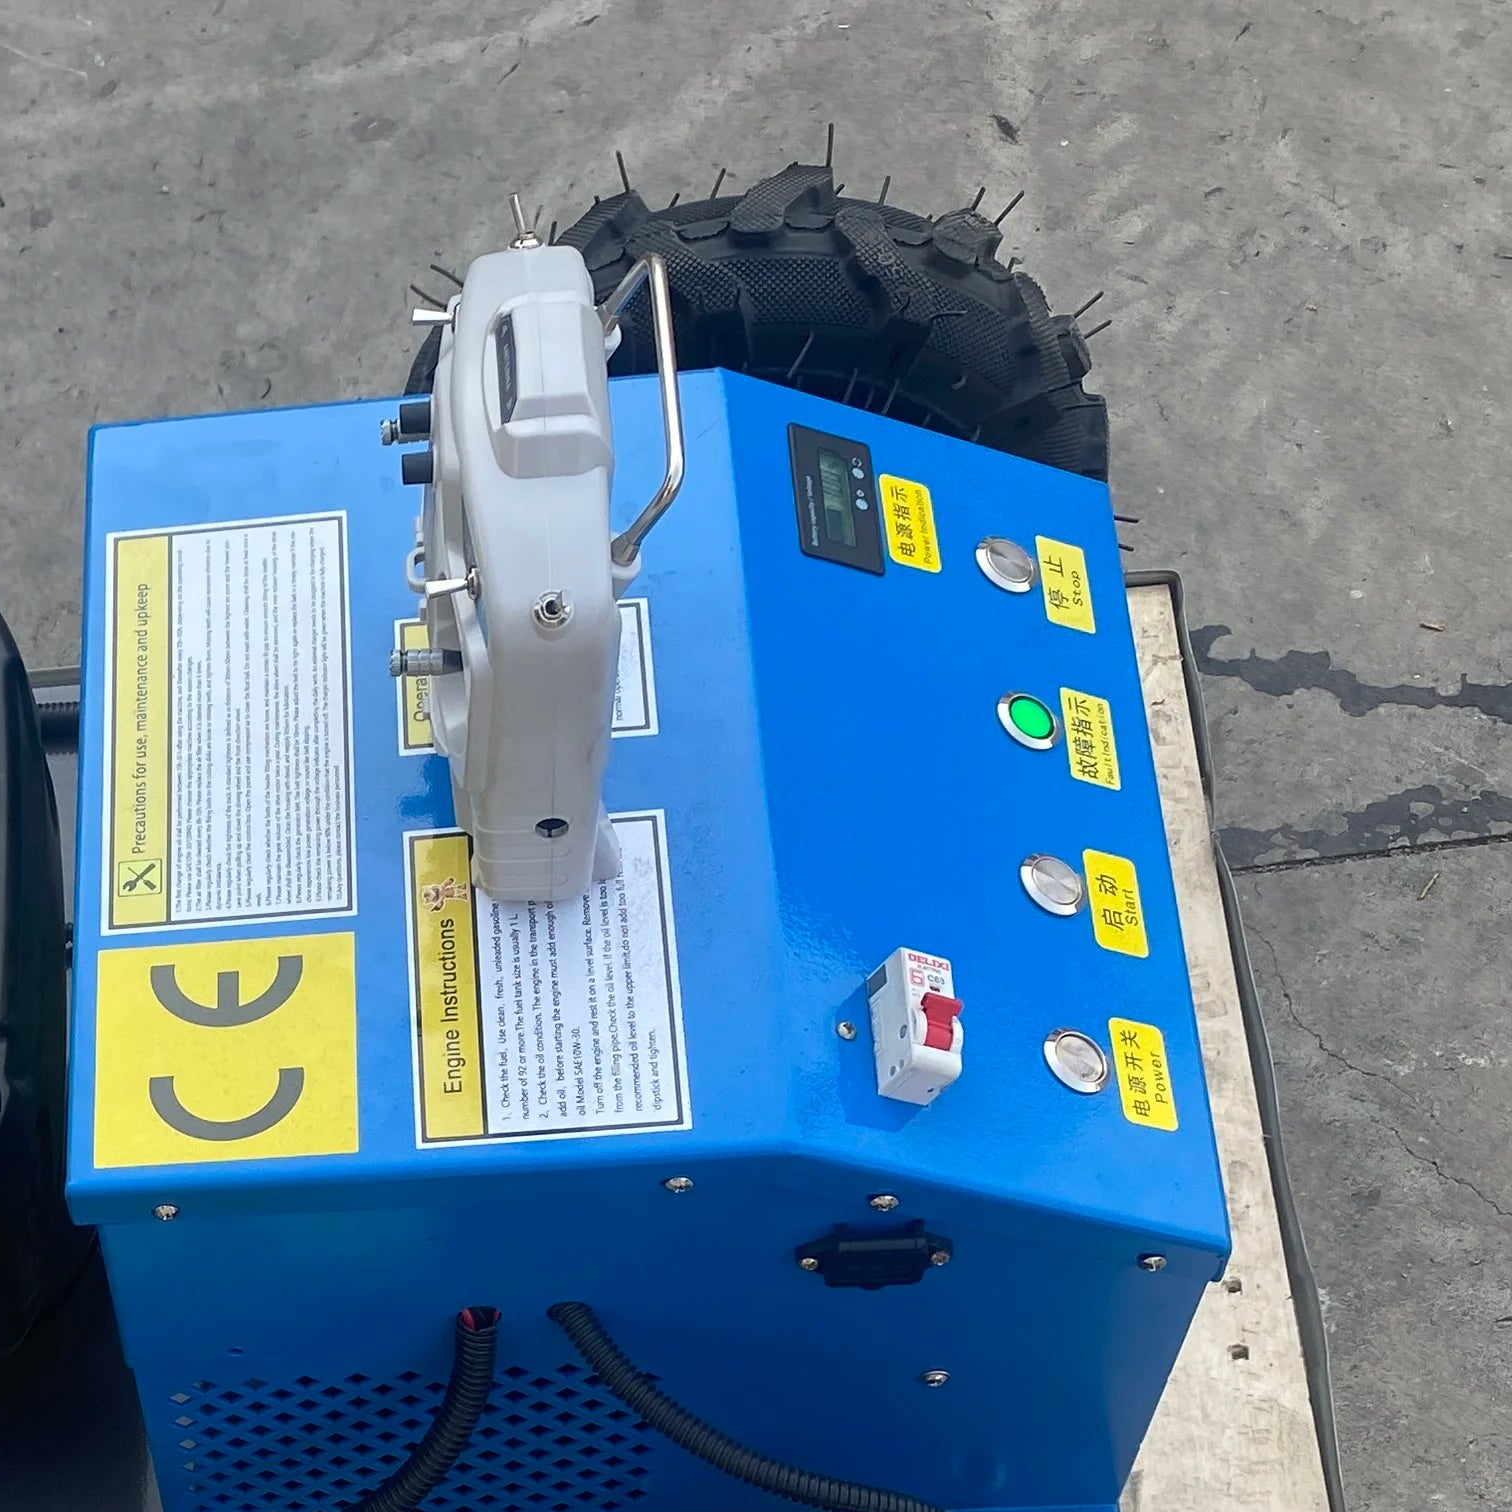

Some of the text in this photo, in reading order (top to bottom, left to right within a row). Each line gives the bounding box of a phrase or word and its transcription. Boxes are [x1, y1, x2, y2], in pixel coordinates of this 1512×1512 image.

[890, 486, 916, 557] 电源指示
[1043, 555, 1070, 609] 停止
[1071, 570, 1083, 607] Stop
[132, 584, 151, 854] Precautions for use, maintenance and upkeep
[1068, 697, 1099, 779] 故障指示
[618, 893, 626, 906] too
[1095, 874, 1124, 931] 启动
[1122, 888, 1138, 926] Start
[582, 895, 591, 925] Remove
[600, 909, 609, 926] level
[618, 908, 628, 923] add
[490, 903, 503, 935] gasoline
[528, 907, 538, 942] transport
[545, 911, 556, 940] enough
[601, 928, 611, 938] oil
[620, 925, 628, 938] not
[510, 929, 521, 955] usually
[529, 944, 538, 957] the
[547, 942, 557, 957] add
[602, 940, 611, 952] the
[492, 936, 502, 972] unleaded
[908, 953, 949, 971] DELIXI
[513, 965, 521, 979] size
[549, 958, 558, 978] must
[585, 959, 594, 976] level
[513, 981, 522, 998] tank
[531, 968, 542, 995] engine
[589, 985, 596, 995] on
[605, 983, 615, 992] oil
[625, 971, 635, 994] upper
[552, 980, 561, 1006] engine
[606, 994, 616, 1007] the
[438, 919, 466, 1093] Engine Instructions
[514, 1000, 523, 1015] fuel
[532, 996, 541, 1011] The
[625, 996, 634, 1009] the
[552, 1008, 560, 1021] the
[589, 1004, 598, 1019] rest
[628, 1011, 635, 1019] to
[498, 1029, 507, 1044] Use
[589, 1021, 599, 1036] and
[627, 1021, 637, 1039] level
[554, 1023, 564, 1053] starting
[628, 1041, 638, 1051] oil
[149, 954, 305, 1142] CE
[592, 1038, 603, 1065] engine
[519, 1055, 526, 1064] or
[535, 1054, 545, 1064] oil
[499, 1069, 508, 1082] the
[518, 1066, 527, 1076] 92
[555, 1055, 565, 1081] before
[593, 1067, 602, 1080] the
[649, 1062, 659, 1077] and
[1120, 1029, 1150, 1117] 电源开关
[518, 1078, 527, 1086] of
[613, 1078, 622, 1091] the
[629, 1053, 642, 1111] recommended
[1150, 1051, 1168, 1104] Power
[500, 1083, 510, 1107] Check
[537, 1080, 547, 1105] Check
[575, 1077, 584, 1103] Model
[594, 1082, 603, 1094] off
[650, 1079, 663, 1110] dipstick
[520, 1088, 529, 1119] number
[557, 1101, 567, 1117] add
[576, 1105, 586, 1116] oil
[596, 1095, 605, 1114] Turn
[614, 1093, 623, 1113] from
